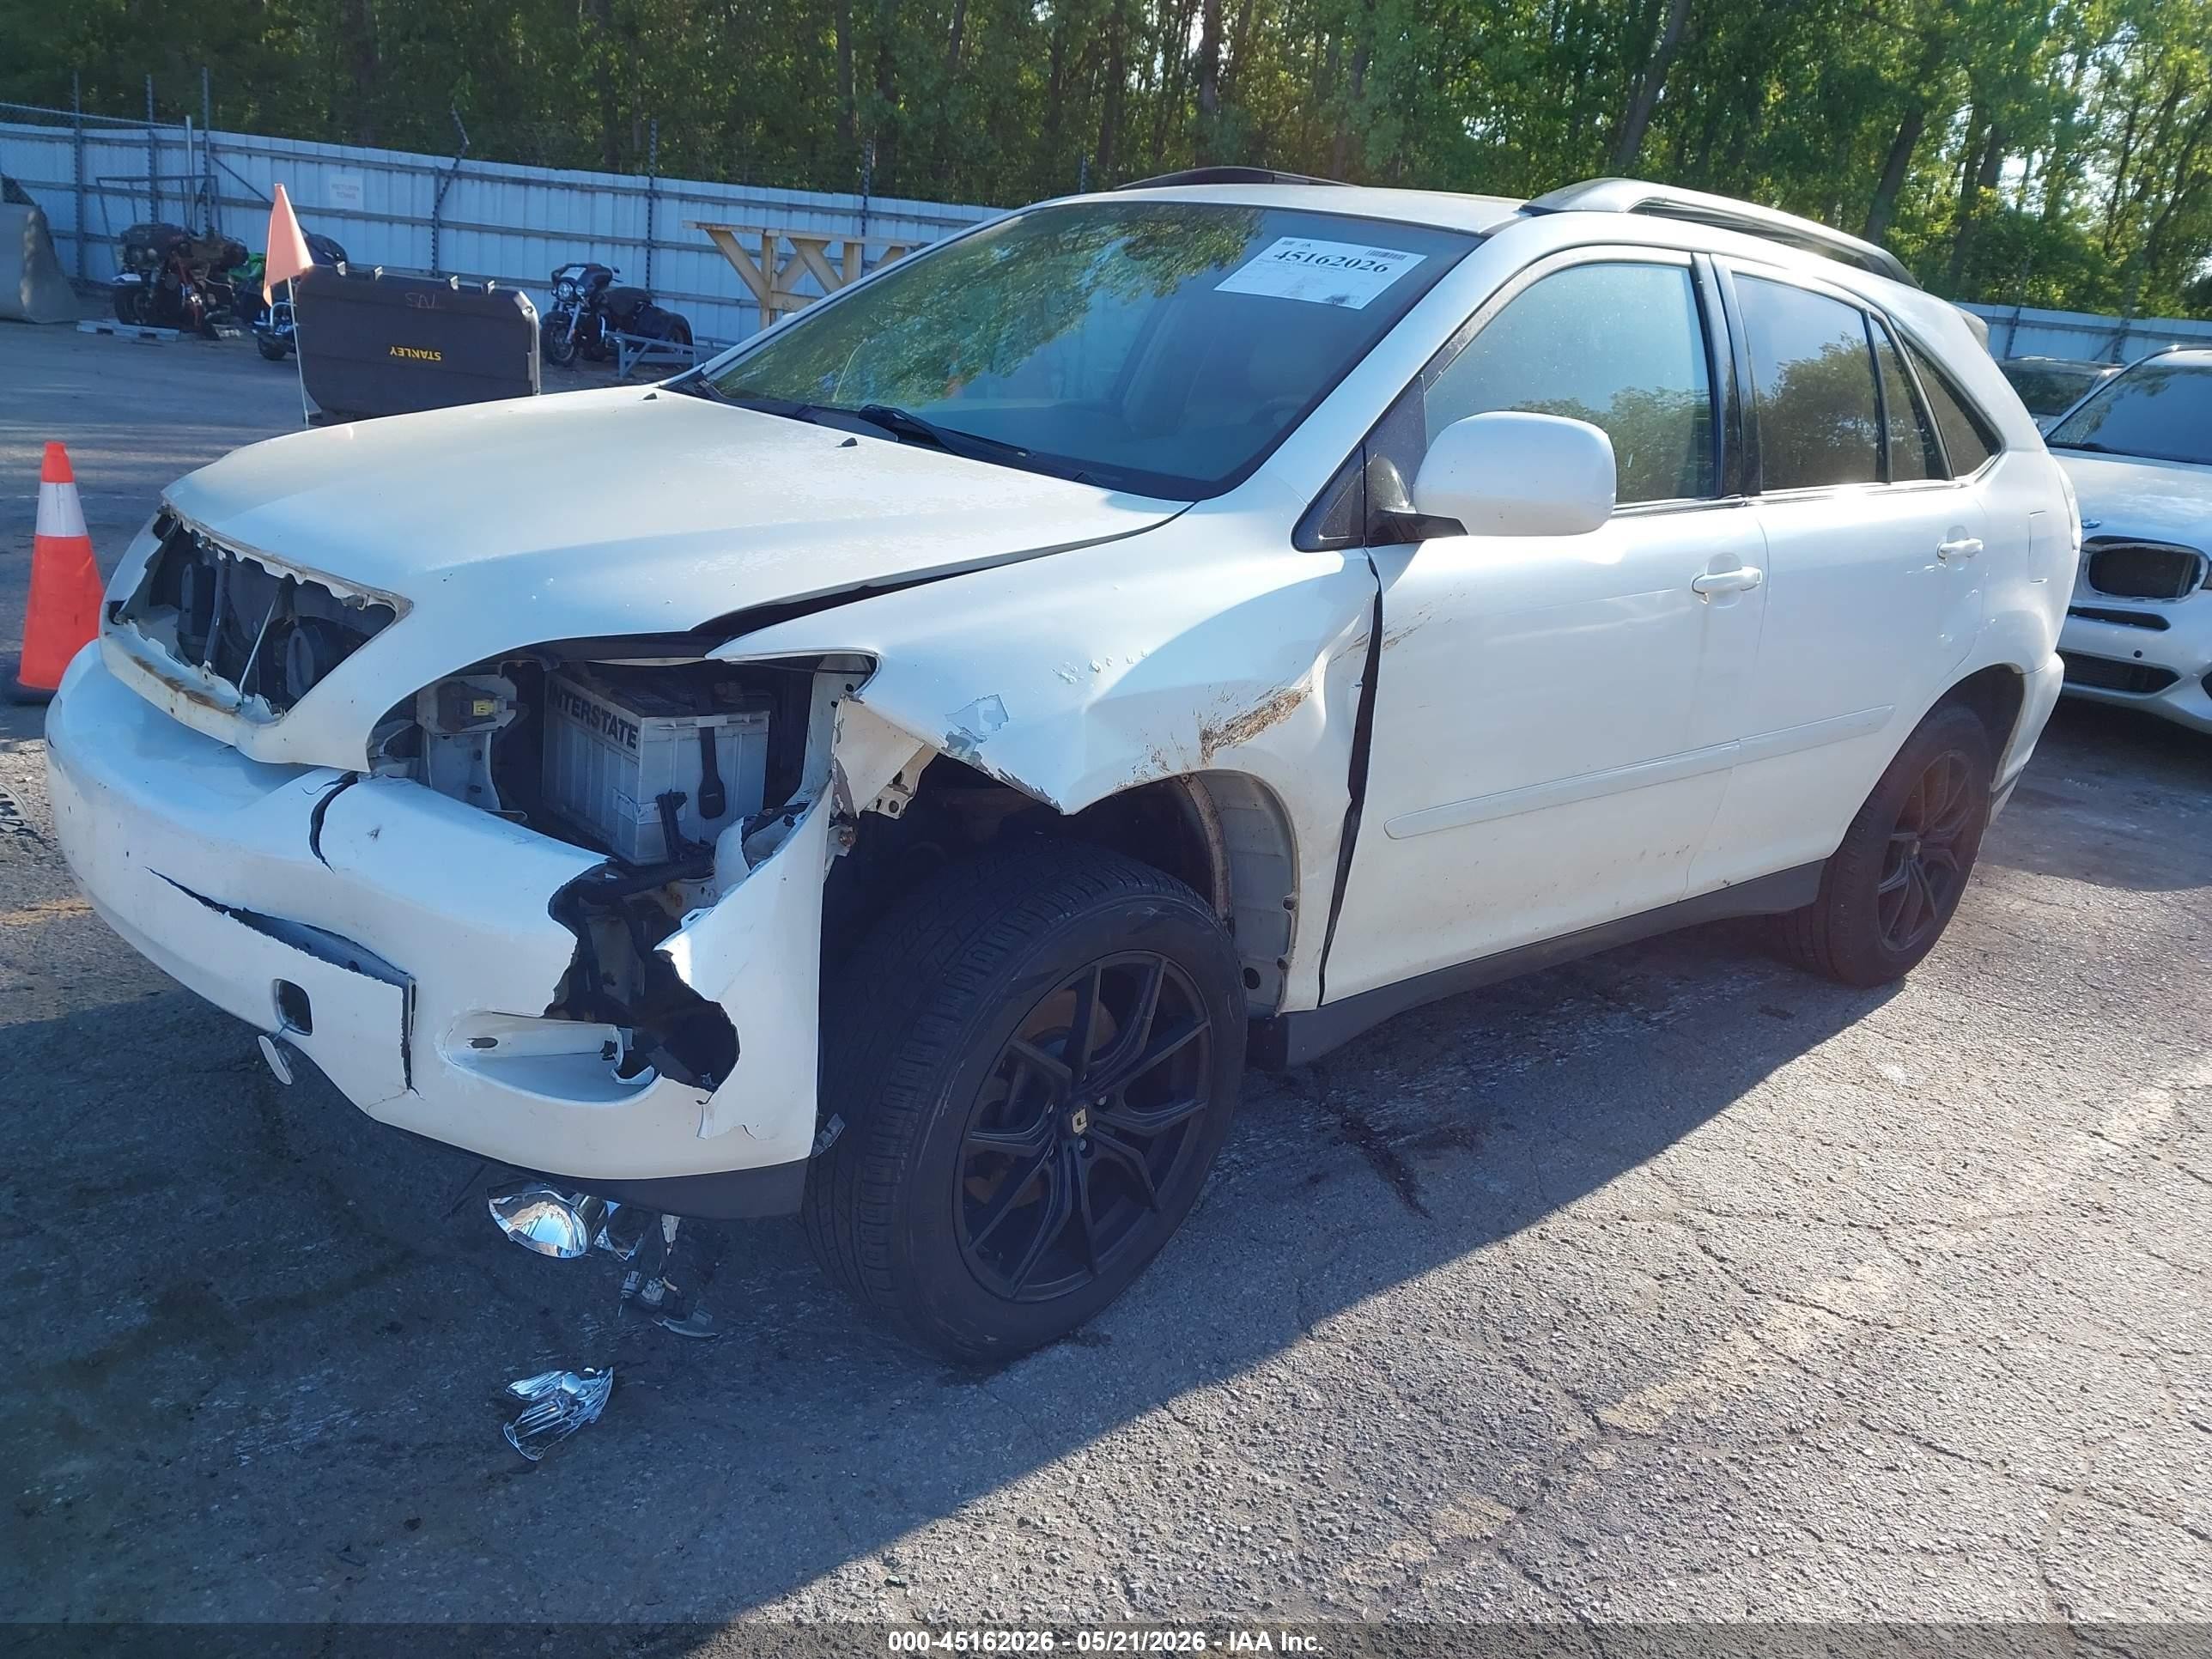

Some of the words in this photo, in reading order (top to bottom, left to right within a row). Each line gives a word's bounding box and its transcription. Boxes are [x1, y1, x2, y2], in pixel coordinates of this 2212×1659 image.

[1274, 250, 1389, 273] 45162026
[390, 346, 441, 361] STANLEY
[549, 681, 638, 749] INTERSTATE
